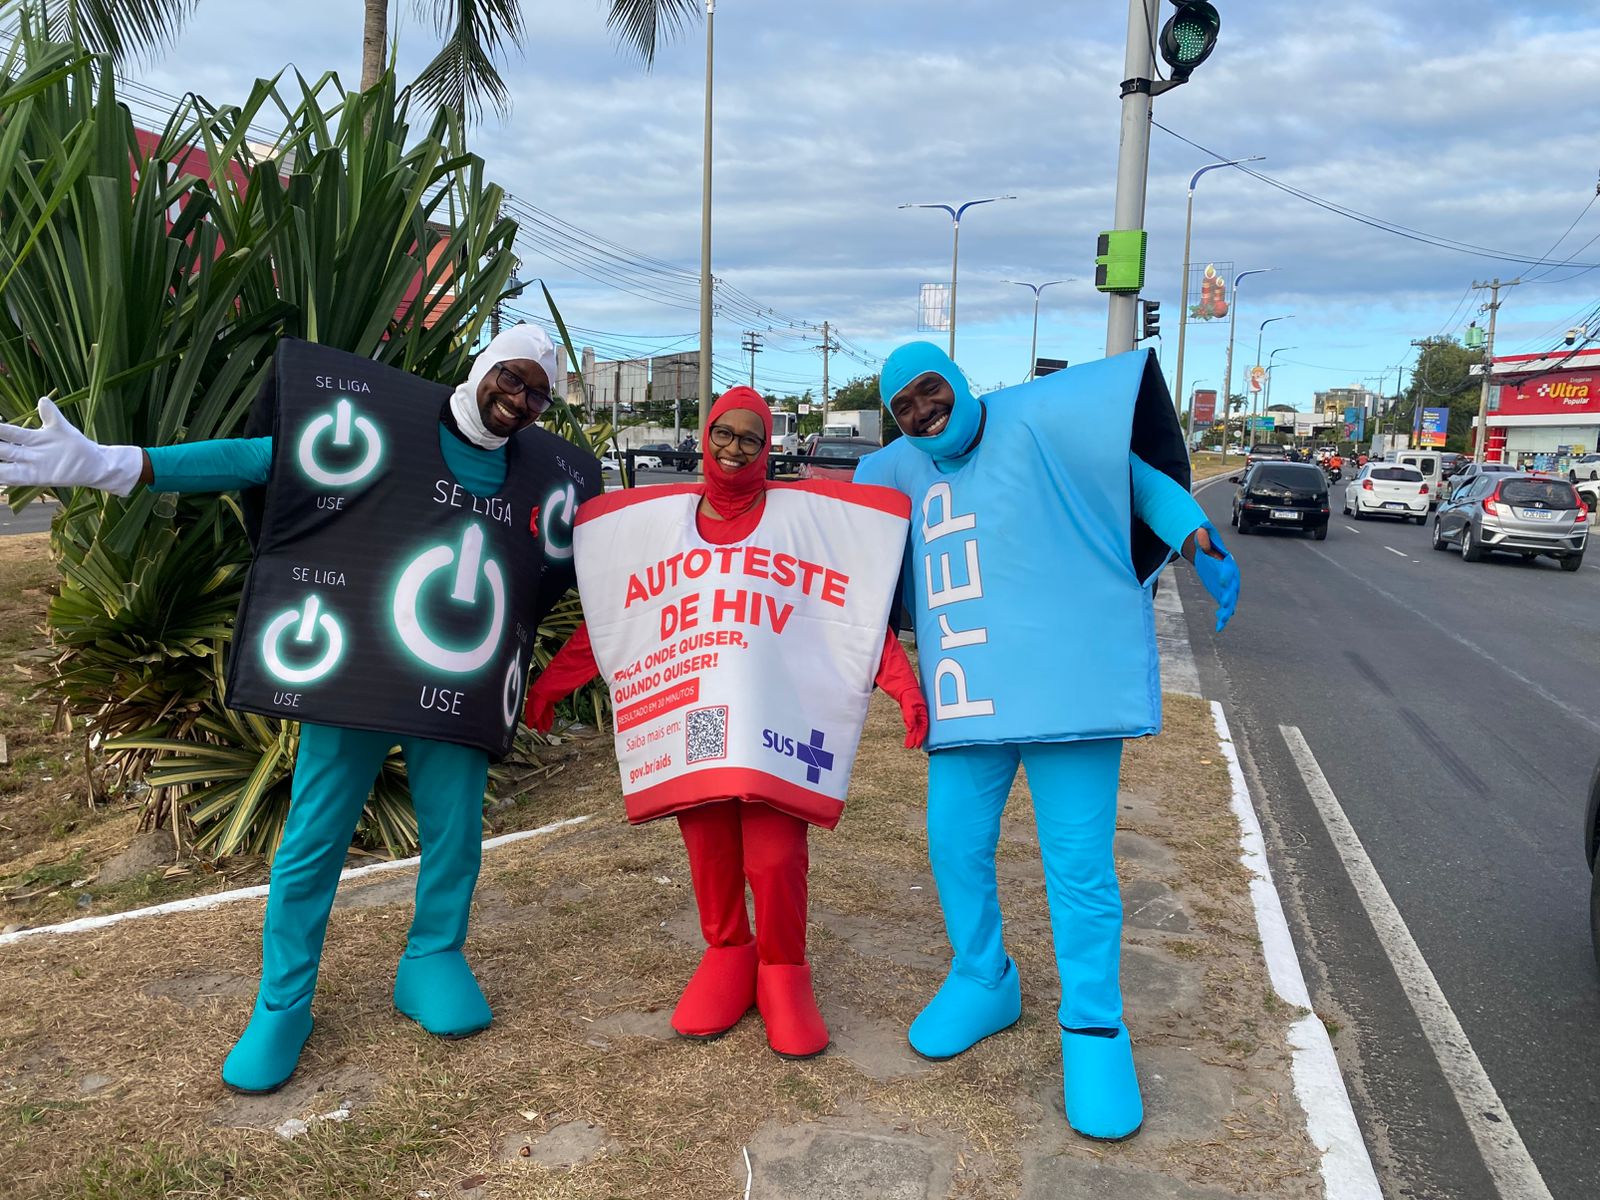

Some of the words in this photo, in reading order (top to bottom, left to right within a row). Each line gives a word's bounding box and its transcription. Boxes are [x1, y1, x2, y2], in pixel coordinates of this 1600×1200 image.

[316, 375, 332, 389] SE
[340, 378, 371, 394] LIGA
[1549, 382, 1589, 398] Ultra
[1563, 397, 1589, 406] Popular
[556, 455, 567, 471] SE
[568, 467, 585, 488] LIGA
[316, 496, 345, 511] USE
[433, 479, 462, 508] SE
[472, 494, 513, 527] LIGA
[292, 566, 310, 582] SE
[315, 569, 346, 587] LIGA
[623, 546, 850, 609] AUTOTESTE
[660, 592, 700, 641] DE
[712, 588, 794, 635] HIV
[922, 480, 995, 721] PrEP
[645, 643, 677, 670] ONDE
[679, 630, 748, 655] QUISER,
[615, 672, 661, 704] QUANDO
[663, 652, 719, 683] QUISER!
[273, 692, 302, 708] USE
[420, 685, 465, 716] USE
[618, 706, 648, 725] RESULTADO
[649, 702, 658, 712] EM
[665, 686, 695, 706] MINUTOS
[626, 735, 646, 752] Saiba
[648, 727, 665, 742] mais
[666, 721, 681, 735] em:
[762, 728, 794, 757] SUS
[629, 753, 672, 784] gov.br/aids
